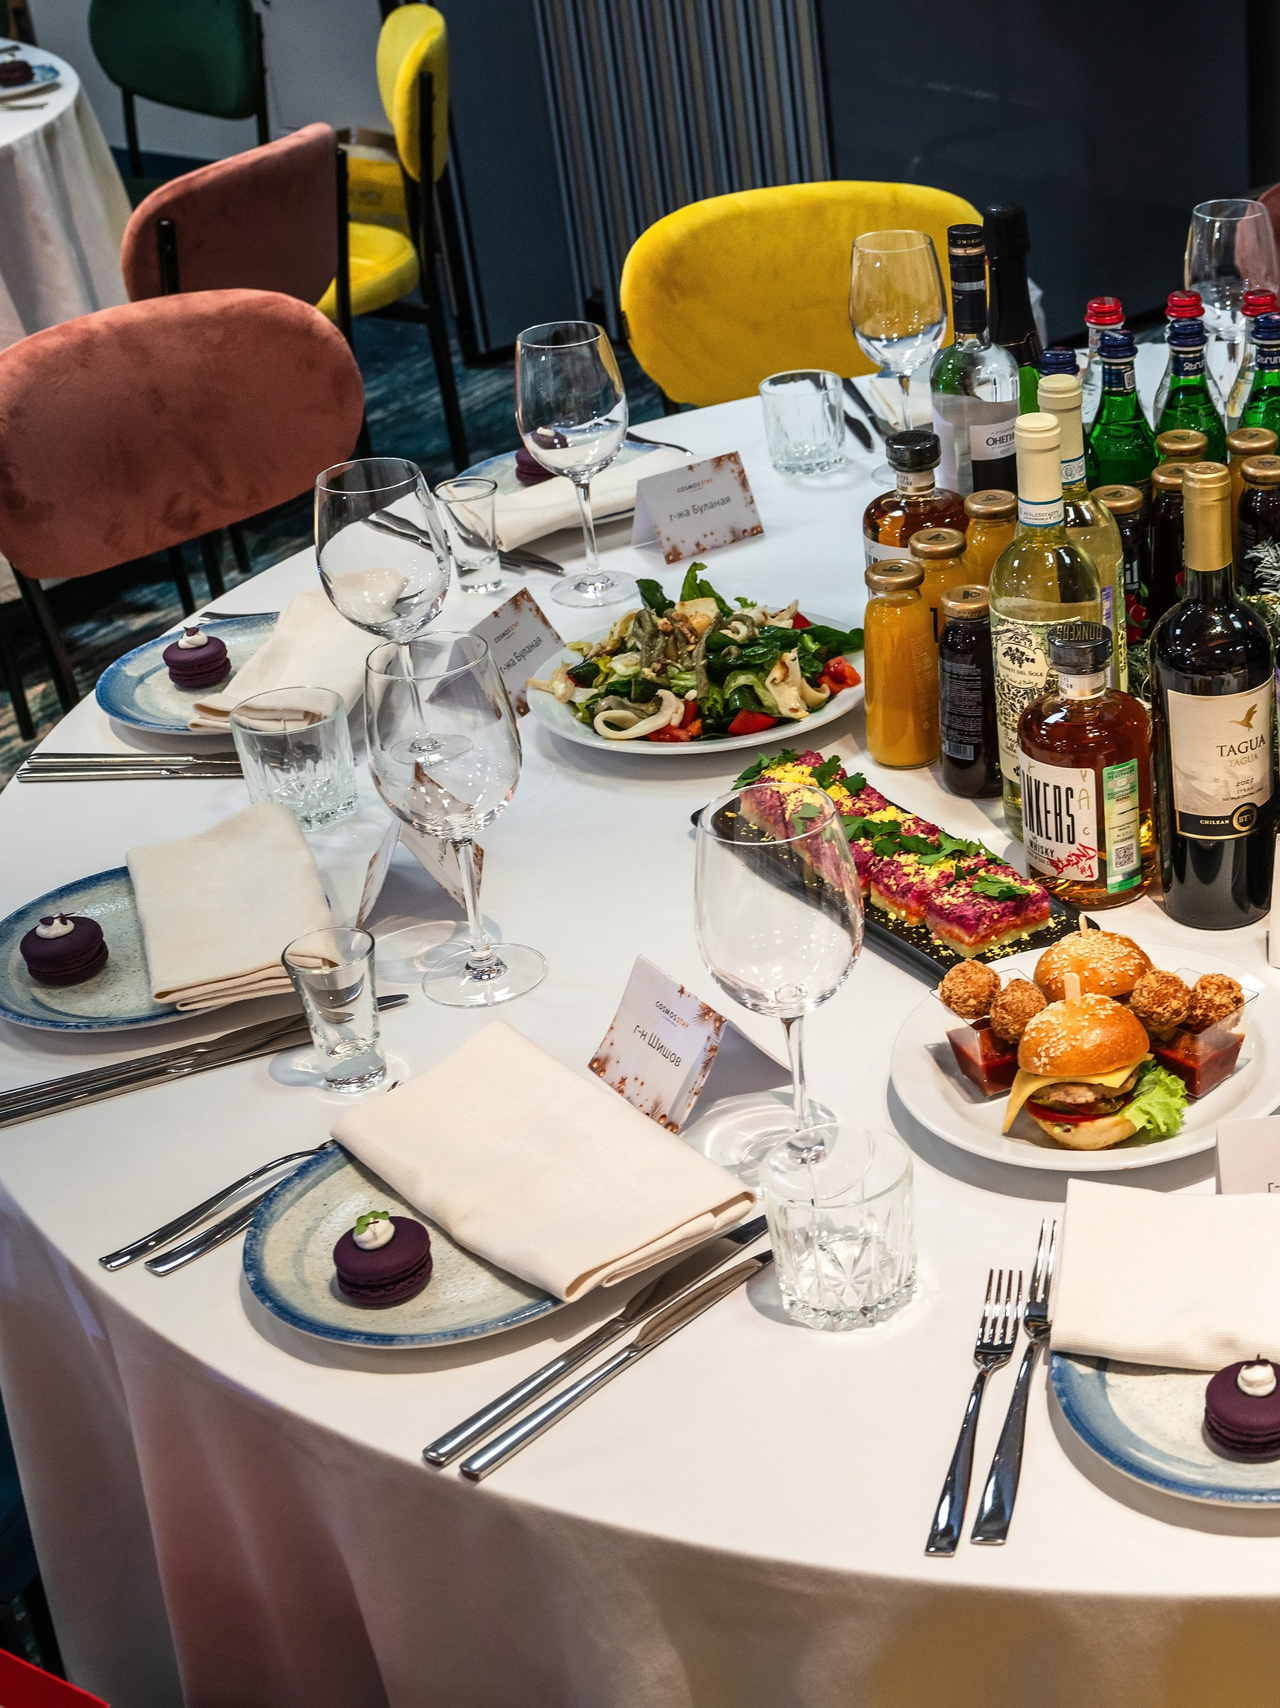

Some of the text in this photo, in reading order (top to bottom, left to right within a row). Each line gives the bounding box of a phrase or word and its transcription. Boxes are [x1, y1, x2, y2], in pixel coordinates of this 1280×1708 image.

[669, 496, 731, 521] г-жа Буланая
[499, 636, 544, 675] г-жа Буланая
[1216, 734, 1266, 758] TAGUA
[1228, 753, 1259, 768] TAGUA
[1029, 838, 1055, 859] WHISKY
[655, 1000, 678, 1021] COSMOS
[676, 1016, 690, 1029] STAY
[632, 1024, 682, 1068] г-н Шишов
